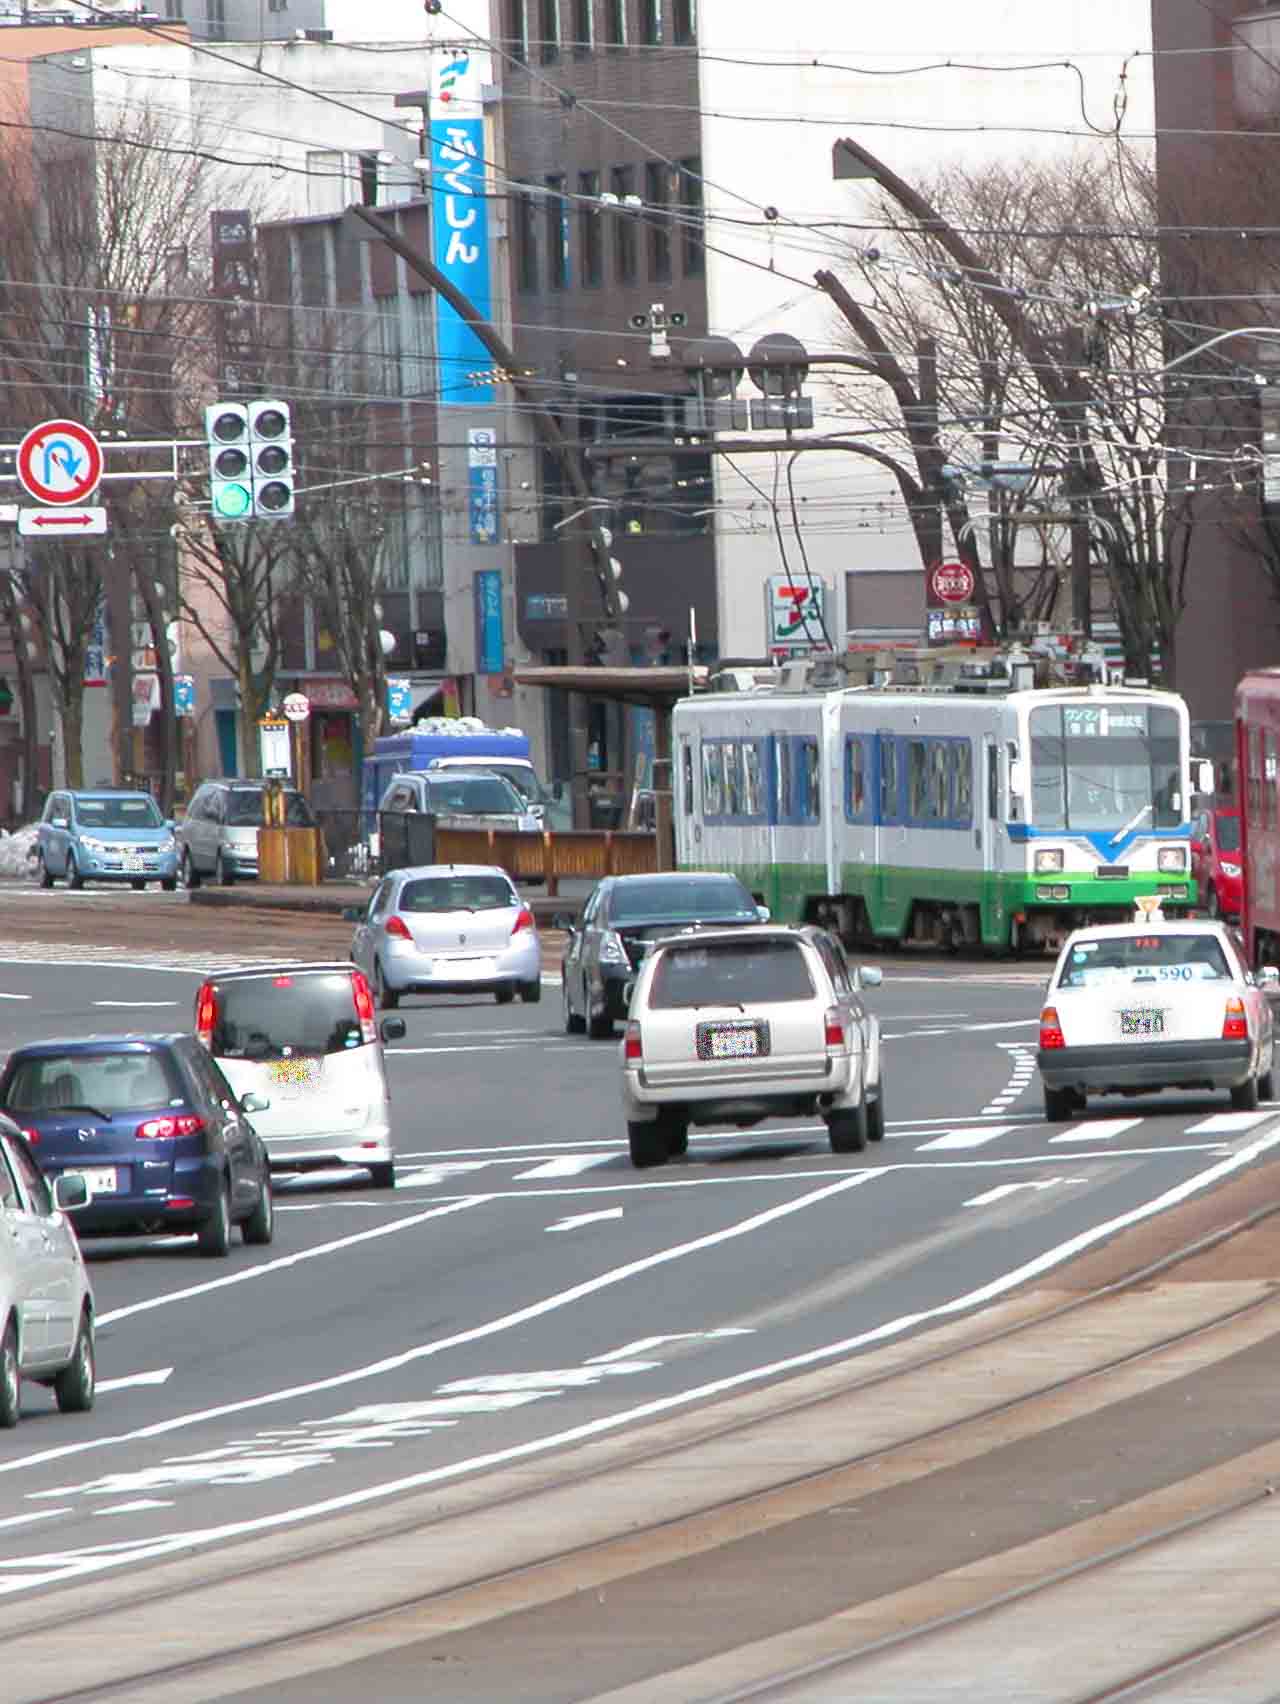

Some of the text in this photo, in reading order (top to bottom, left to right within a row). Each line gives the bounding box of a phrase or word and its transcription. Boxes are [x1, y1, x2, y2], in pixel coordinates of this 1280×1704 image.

[439, 127, 479, 264] ふくしん
[1158, 966, 1193, 981] 590
